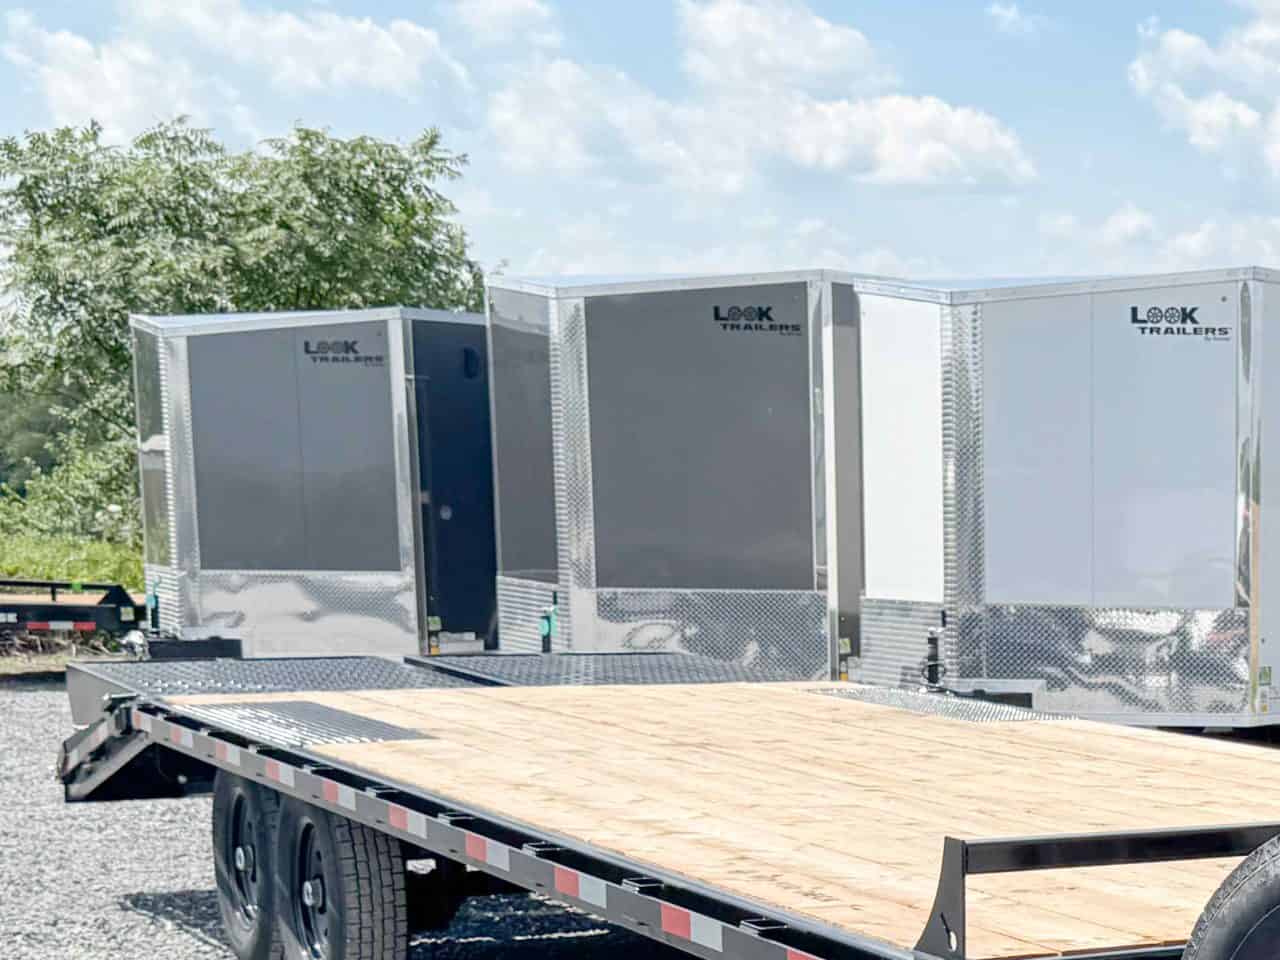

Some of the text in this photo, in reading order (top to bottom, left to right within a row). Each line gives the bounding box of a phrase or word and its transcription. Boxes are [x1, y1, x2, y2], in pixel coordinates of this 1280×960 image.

[712, 305, 775, 321] LOOK
[1130, 306, 1200, 325] LOOK
[720, 322, 801, 332] TRAILERS
[1137, 327, 1232, 336] TRAILERS
[304, 340, 360, 355] LOOK
